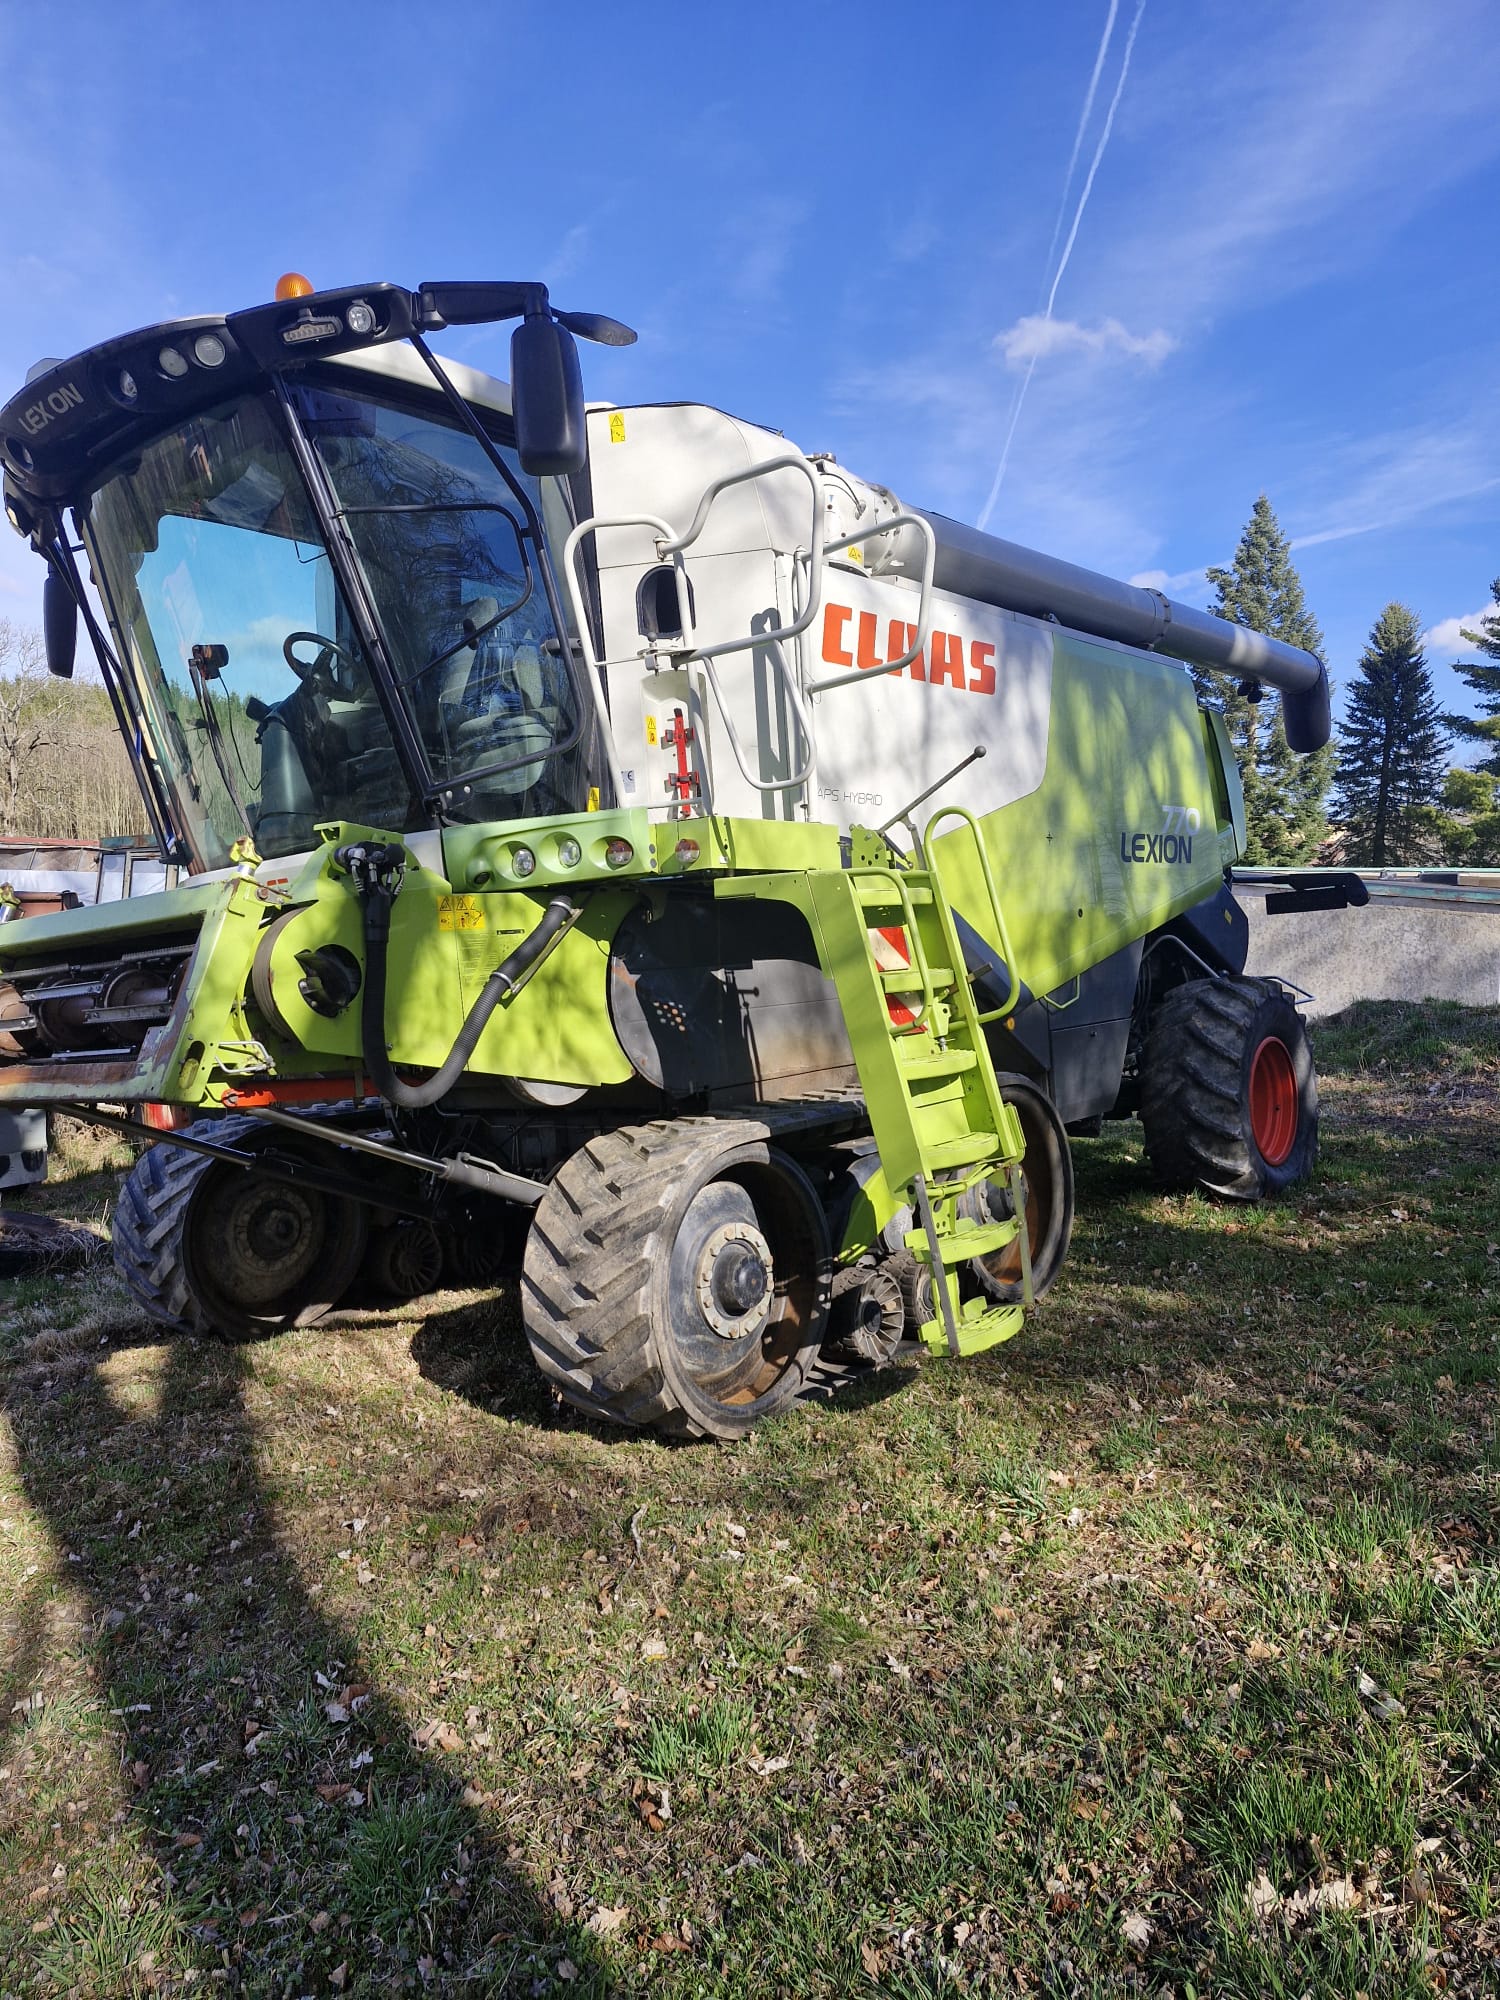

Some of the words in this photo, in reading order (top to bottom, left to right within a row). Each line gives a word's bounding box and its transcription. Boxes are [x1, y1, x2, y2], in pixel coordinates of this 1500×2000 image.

[822, 602, 996, 695] CLAAS
[818, 788, 840, 802] APS
[843, 791, 883, 806] HYBRID
[1162, 804, 1200, 836] 770
[1120, 832, 1192, 864] LEXION
